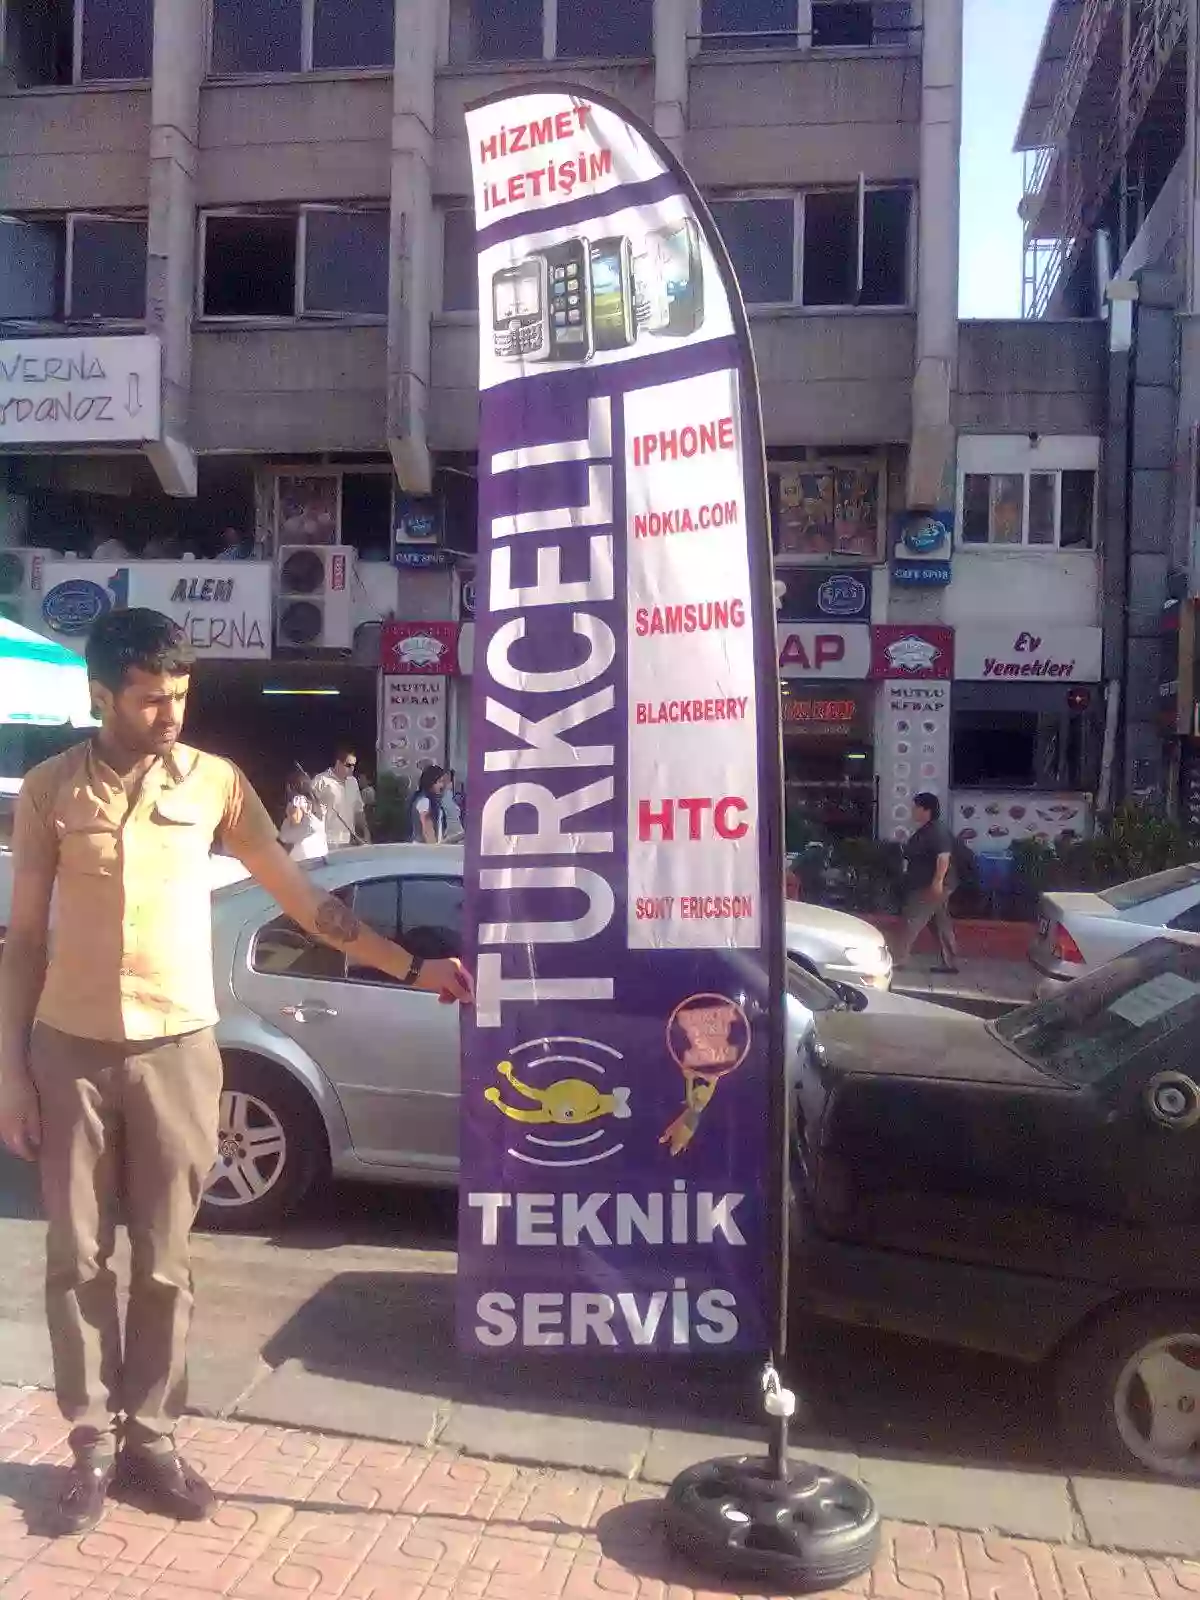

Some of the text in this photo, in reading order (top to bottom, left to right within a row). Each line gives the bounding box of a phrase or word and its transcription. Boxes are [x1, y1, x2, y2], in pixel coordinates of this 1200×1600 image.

[480, 105, 591, 164] HİZMET
[484, 149, 612, 211] İLETİŞİM
[632, 417, 734, 466] IPHONE
[634, 501, 738, 538] NOKIA.COM
[171, 576, 234, 602] ALEM
[636, 599, 745, 636] SAMSUNG
[1014, 632, 1041, 651] Ev
[984, 659, 1075, 677] Yemekleri
[636, 697, 748, 725] BLACKBERRY
[891, 688, 944, 698] MUTLU
[476, 396, 616, 1028] TURKCELL
[638, 797, 749, 842] HTC
[636, 896, 752, 920] SONY ERICSSON
[468, 1179, 747, 1246] TEKNİK
[475, 1277, 739, 1346] SERVİS
